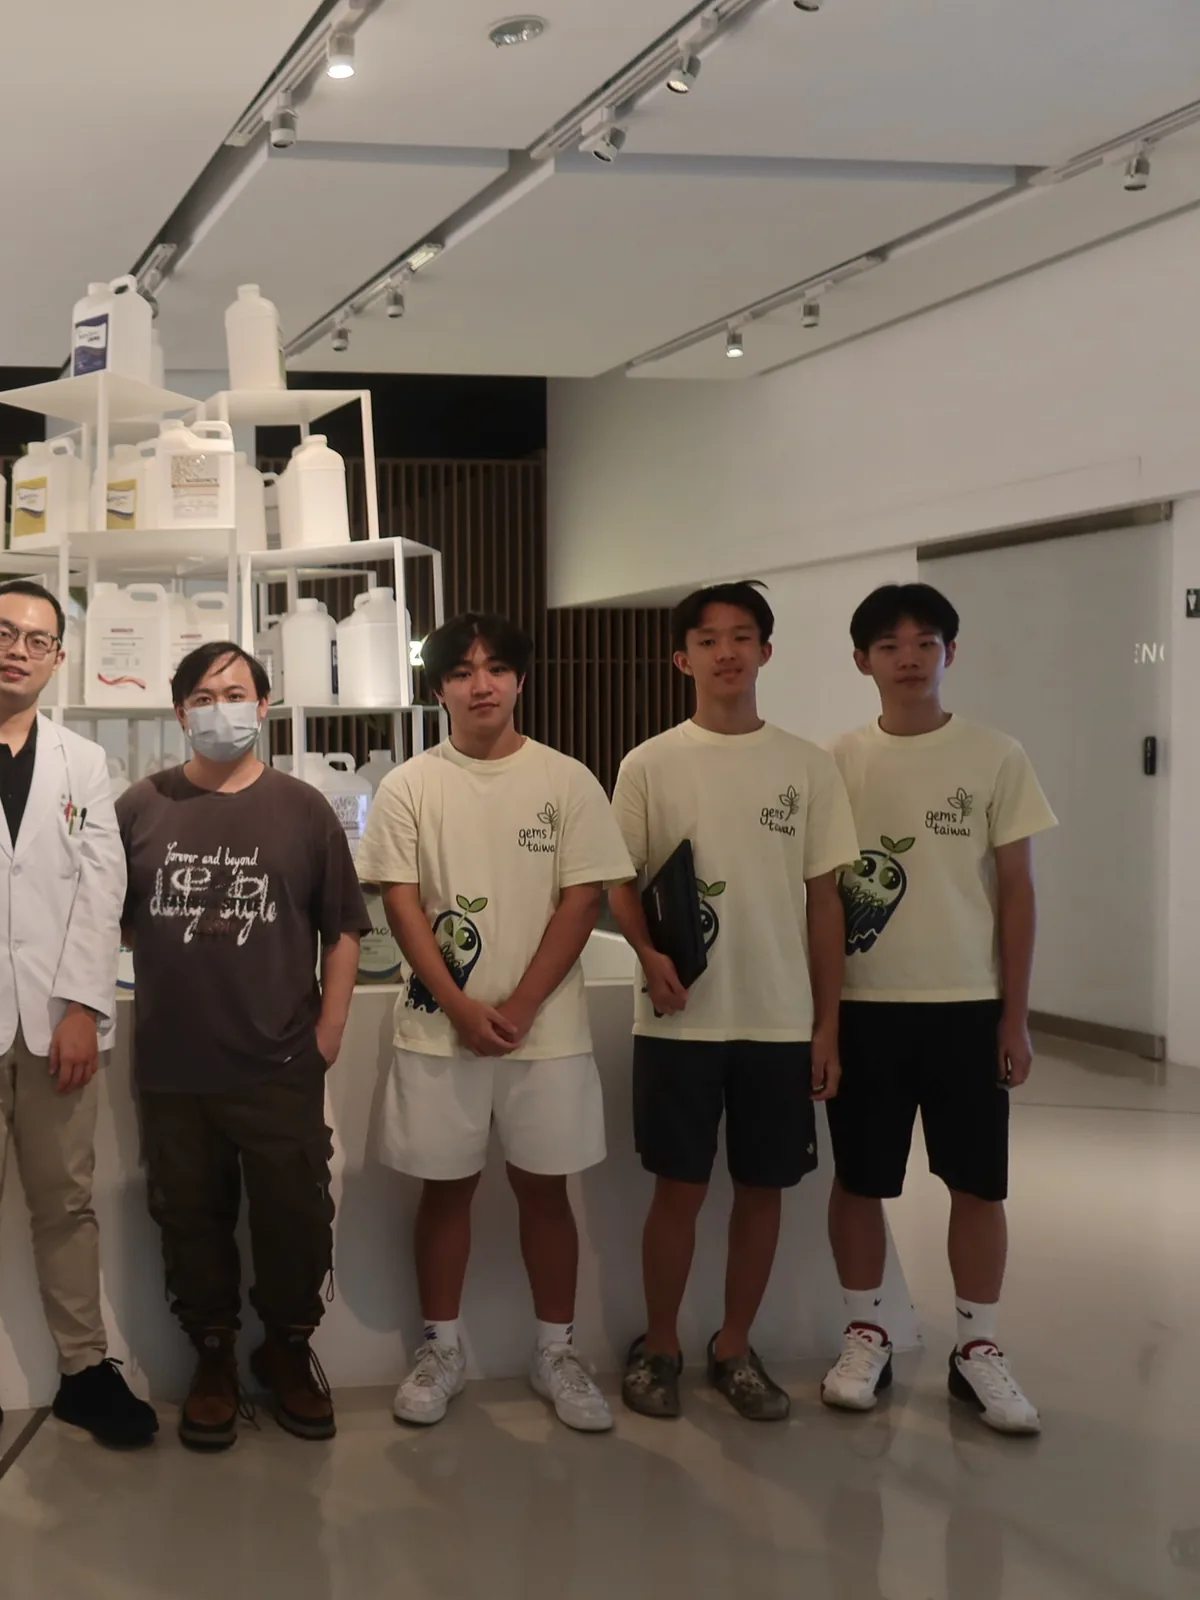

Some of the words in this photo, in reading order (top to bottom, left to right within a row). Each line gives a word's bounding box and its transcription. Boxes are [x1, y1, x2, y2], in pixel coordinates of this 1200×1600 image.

[925, 811, 957, 828] gems
[518, 828, 547, 847] gems
[526, 840, 556, 852] taiwa
